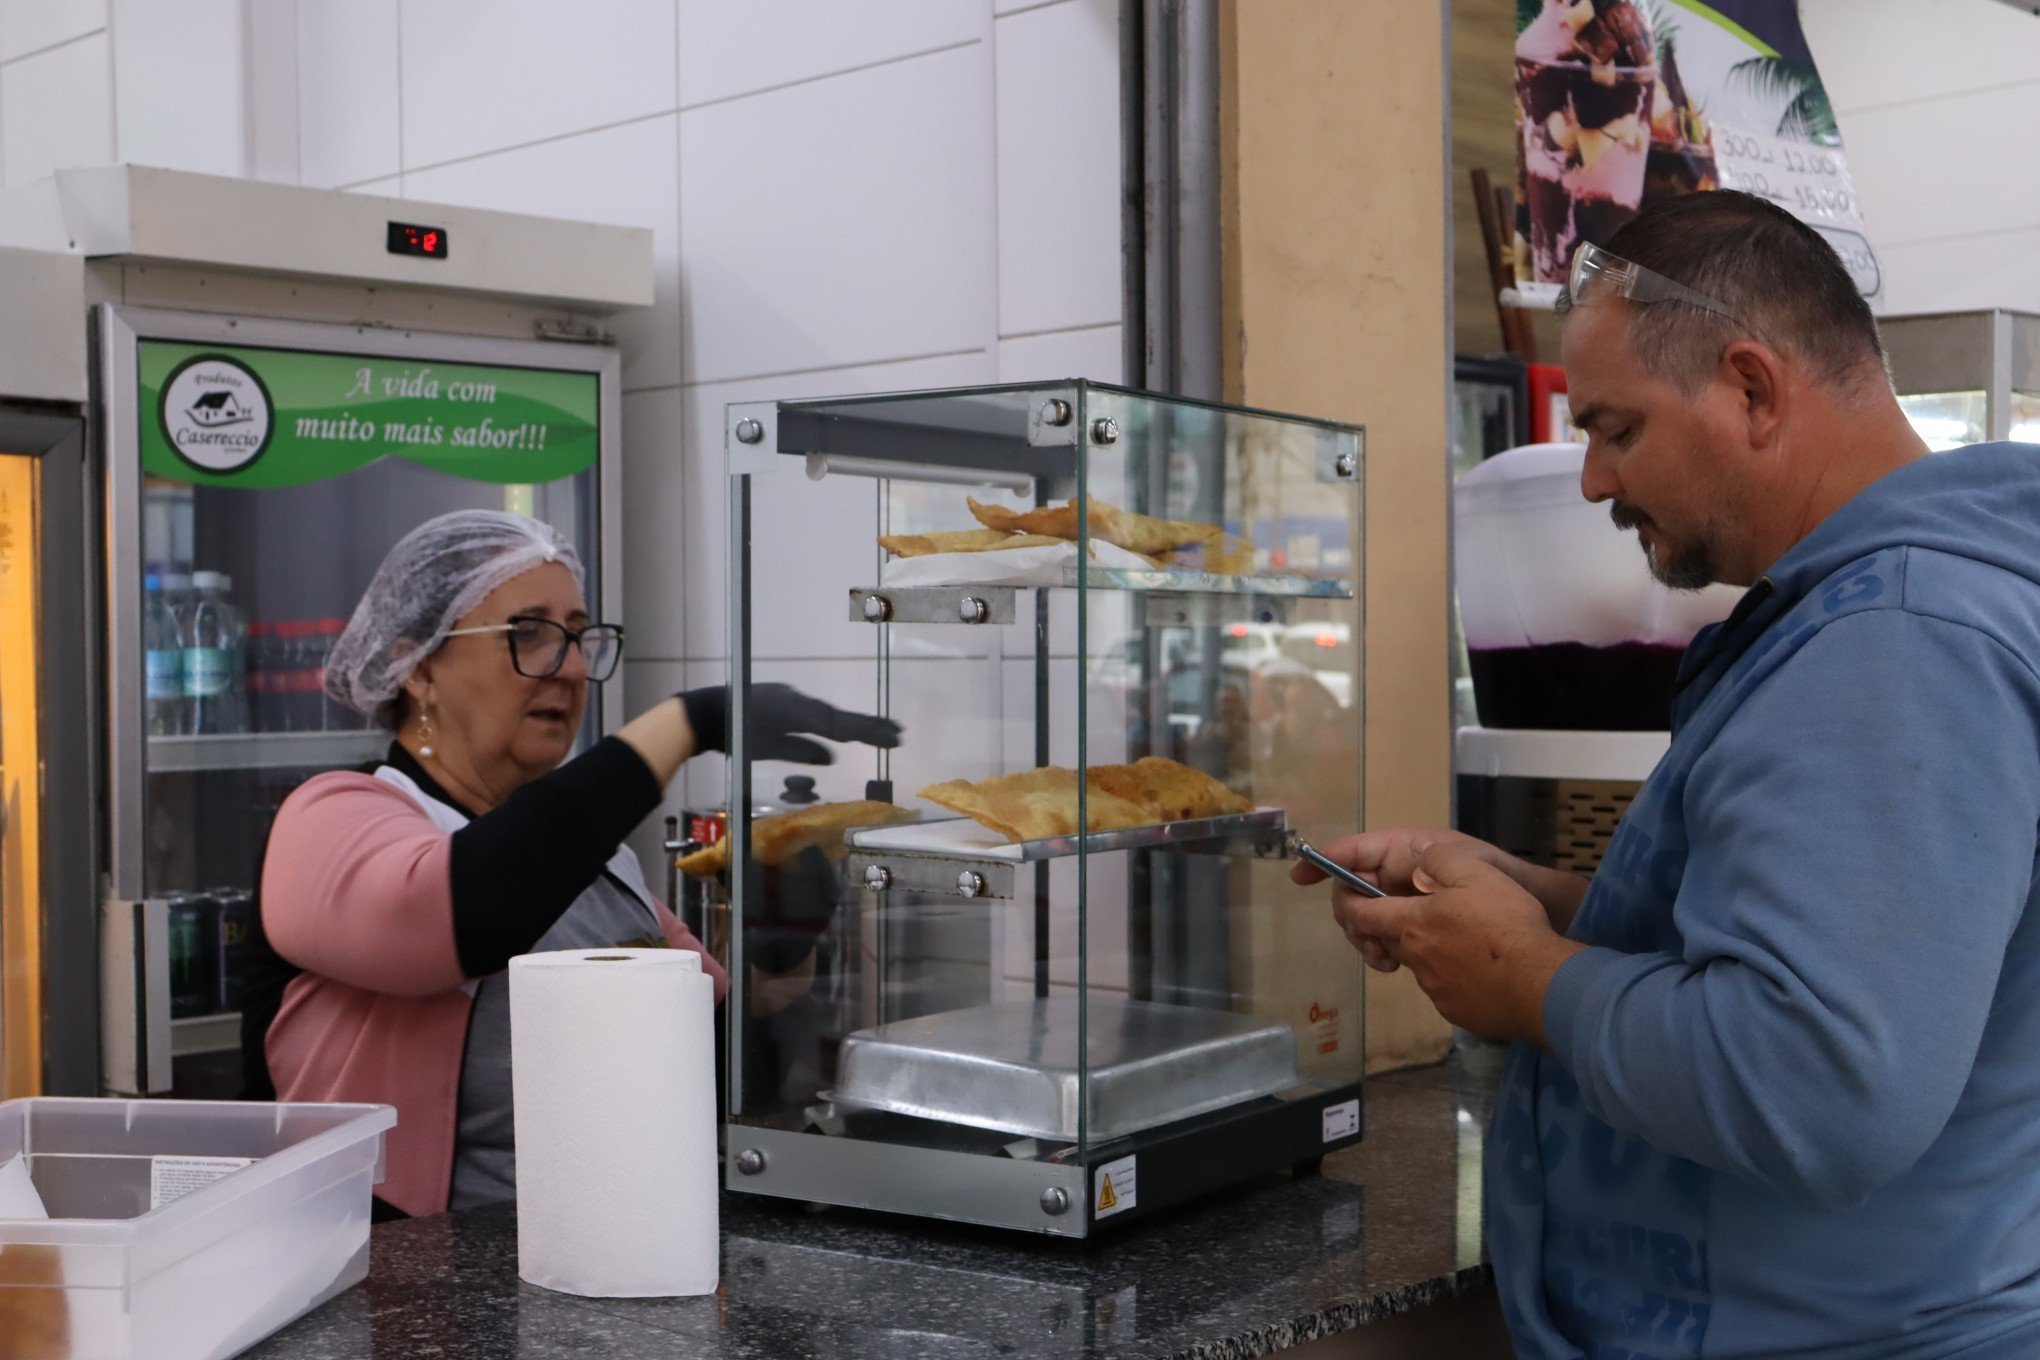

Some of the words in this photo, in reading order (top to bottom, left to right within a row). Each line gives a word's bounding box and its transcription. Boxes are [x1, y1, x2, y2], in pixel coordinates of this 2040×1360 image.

[345, 367, 372, 398] A
[382, 368, 440, 399] vida
[448, 381, 497, 404] com
[175, 427, 260, 446] Casereccio
[295, 412, 376, 441] muito
[384, 416, 444, 445] mais
[450, 417, 548, 450] sabor!!!
